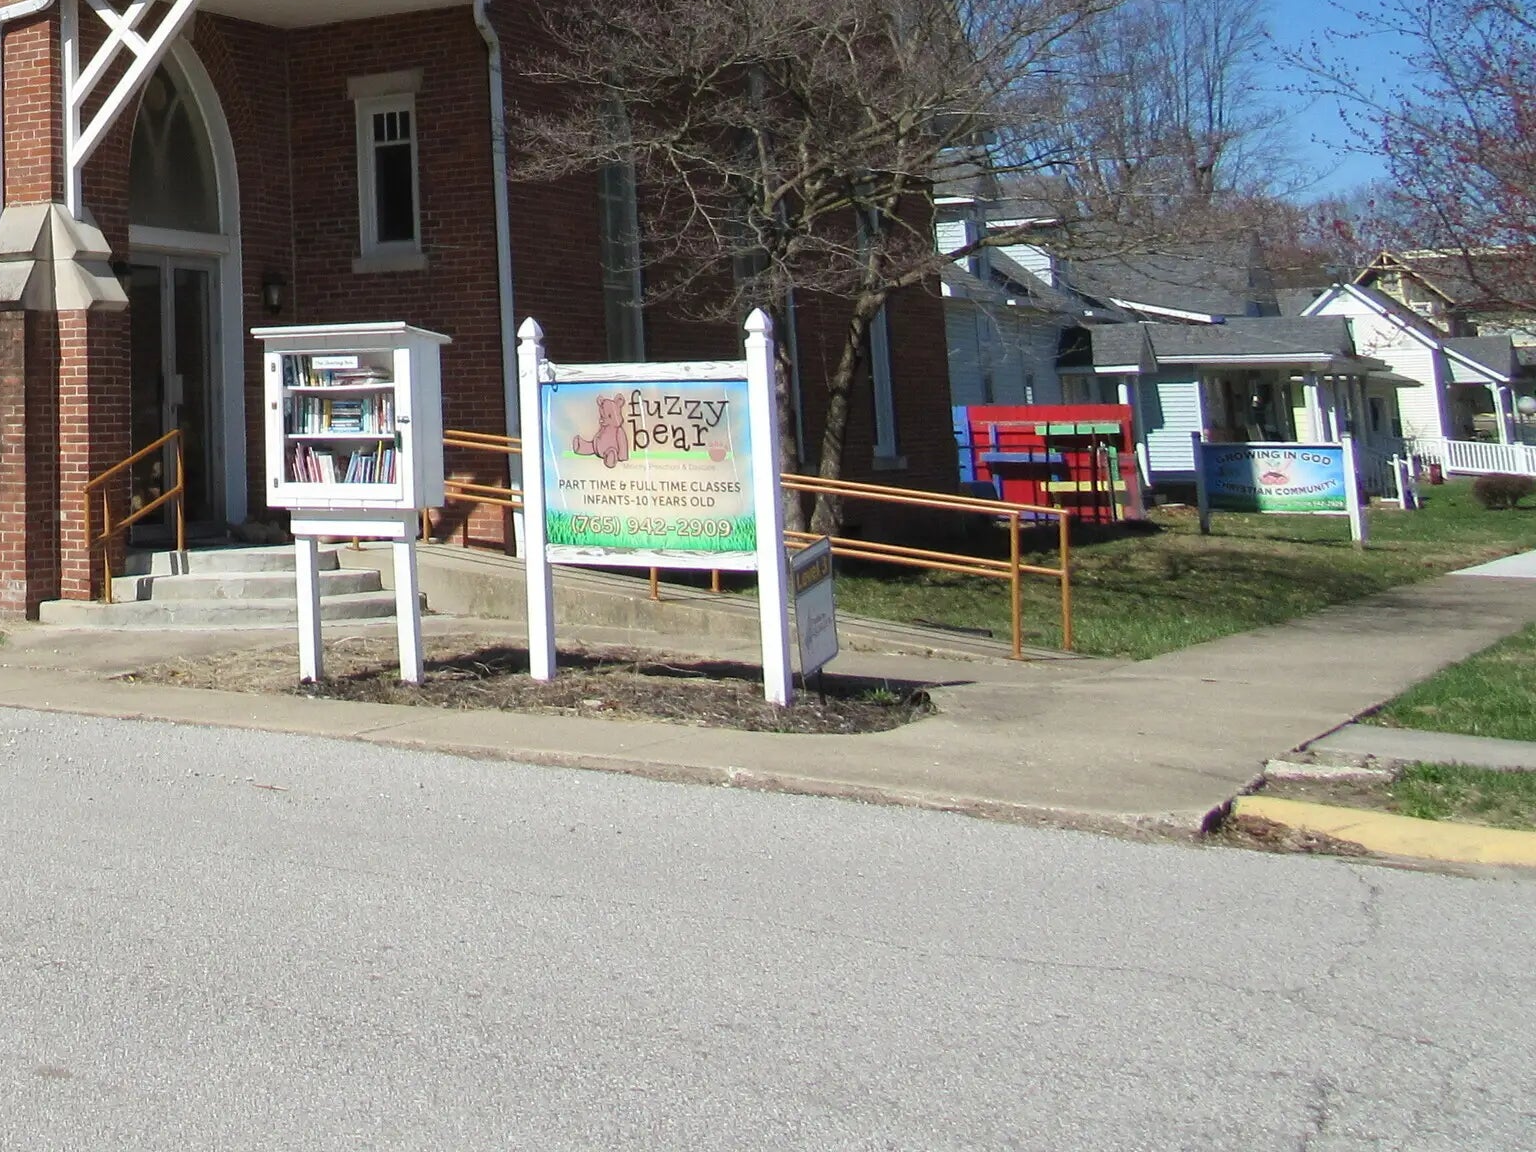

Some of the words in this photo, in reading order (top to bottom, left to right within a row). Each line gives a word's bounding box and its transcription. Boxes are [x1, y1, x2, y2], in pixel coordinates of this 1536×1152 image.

[627, 389, 729, 427] fuzzy
[627, 419, 709, 452] bear
[1216, 450, 1280, 464] GROWING
[1284, 451, 1297, 460] IN
[1301, 452, 1332, 466] GOD
[559, 479, 586, 490] PART
[589, 480, 616, 491] TIME
[619, 480, 626, 491] &
[630, 481, 657, 491] FULL
[659, 481, 687, 492] TIME
[690, 481, 741, 493] CLASSES
[1275, 479, 1337, 496] COMMUNITY
[583, 495, 648, 506] INFANTS-10
[652, 496, 687, 507] YEARS
[691, 496, 715, 507] OLD
[571, 515, 620, 535] (765)
[628, 517, 733, 537] 942-2909
